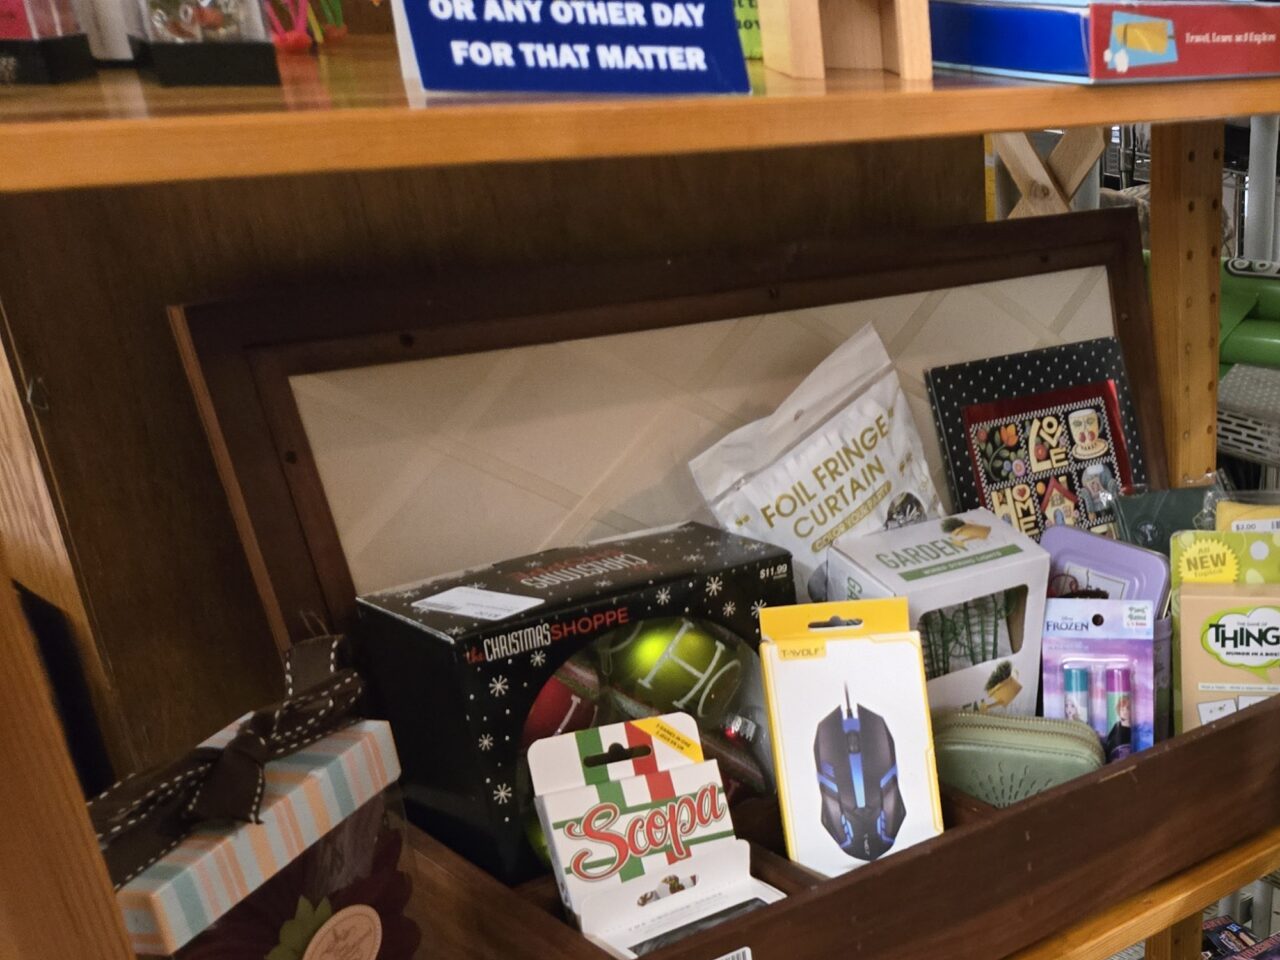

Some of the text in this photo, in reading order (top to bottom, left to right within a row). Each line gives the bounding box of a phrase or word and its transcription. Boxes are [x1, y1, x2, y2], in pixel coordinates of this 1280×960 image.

[428, 0, 706, 28] OR ANY OTHER DAY
[450, 40, 708, 71] FOR THAT MATTER
[1028, 415, 1069, 474] LOVE
[760, 414, 890, 528] FOIL FRINGE
[793, 454, 886, 538] CURTAIN
[875, 537, 968, 569] GARDEN
[1186, 552, 1227, 571] NEW
[760, 564, 788, 580] $11.99
[483, 623, 551, 662] CHRISTMAS
[550, 607, 630, 642] SHOPPE
[1046, 621, 1089, 632] FROZEN
[564, 781, 727, 882] Scopa
